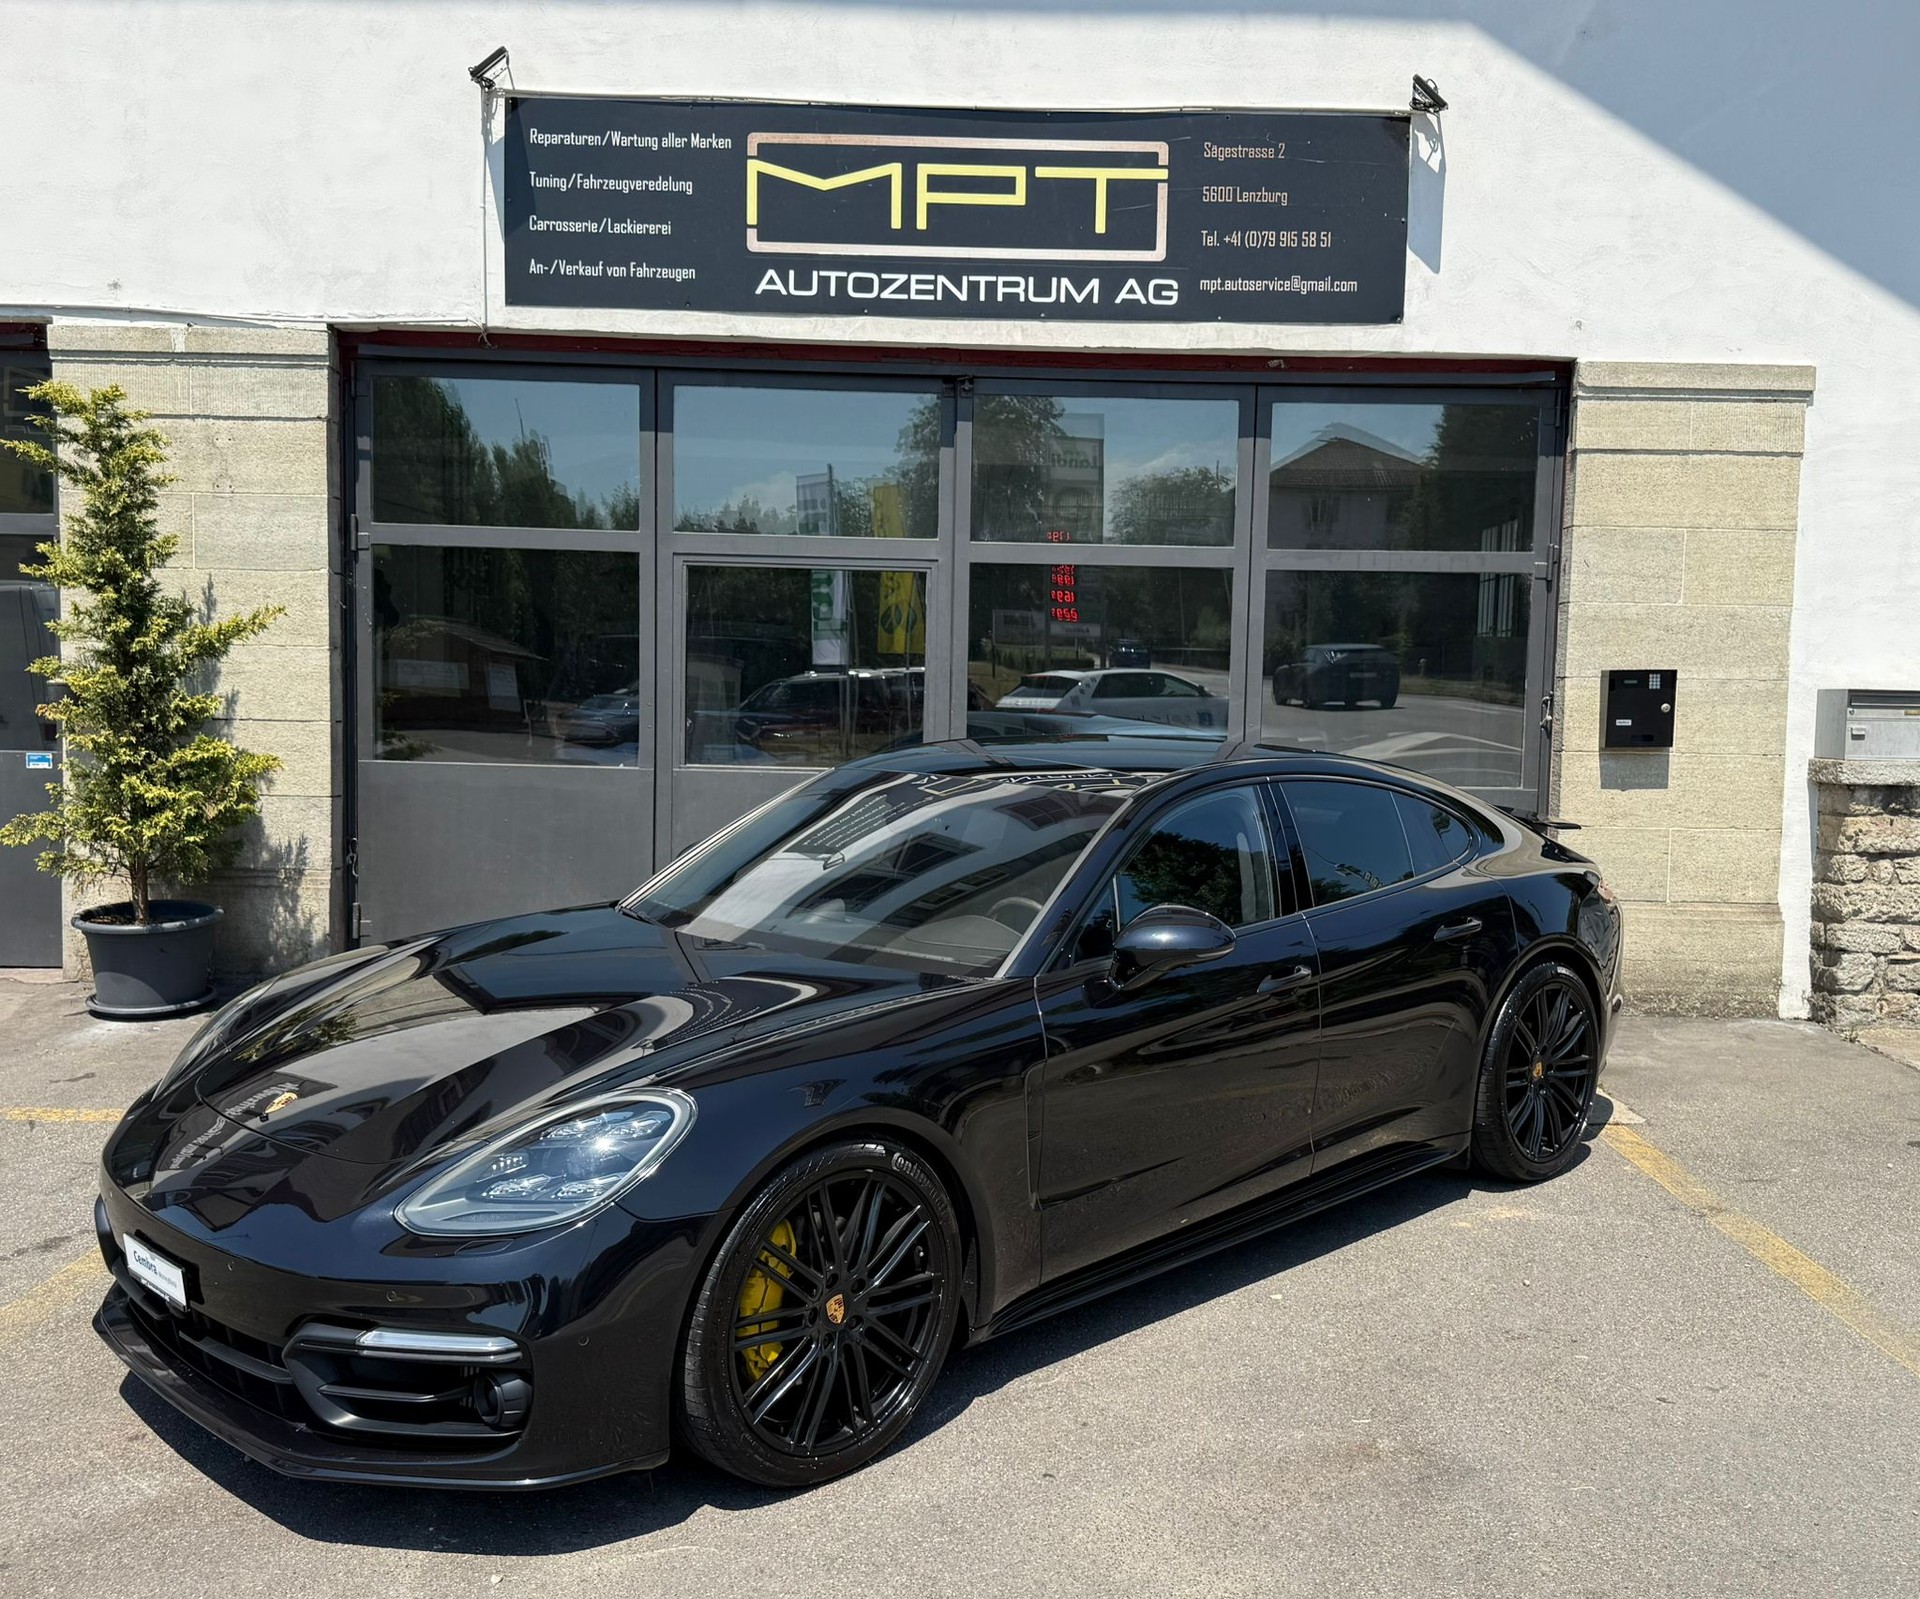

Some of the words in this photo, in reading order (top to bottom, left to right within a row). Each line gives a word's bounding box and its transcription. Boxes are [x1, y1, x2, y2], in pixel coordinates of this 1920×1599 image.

[529, 127, 659, 151] Reparaturen/Wartung
[661, 131, 688, 149] aller
[690, 132, 732, 149] Marken
[1203, 141, 1275, 162] Sägestrasse
[1277, 142, 1286, 159] 2
[529, 170, 693, 196] Tuning/Fahrzeugveredelung
[746, 158, 1169, 234] MPT
[1202, 185, 1233, 203] 5600
[1236, 186, 1288, 207] Lenzburg
[529, 214, 672, 236] Carrosserie/Lackiererei
[1200, 230, 1220, 247] Tel.
[1223, 230, 1242, 247] +41
[1244, 230, 1276, 249] (0)79
[1279, 230, 1298, 248] 915
[1301, 231, 1317, 248] 58
[1319, 231, 1332, 248] 51
[529, 258, 604, 277] An-/Verkauf
[605, 266, 627, 278] von
[629, 261, 696, 283] Fahrzeugen
[754, 268, 1100, 304] AUTOZENTRUM
[1114, 278, 1179, 306] AG
[1199, 275, 1358, 295] mpt.autoservice@gmail.com
